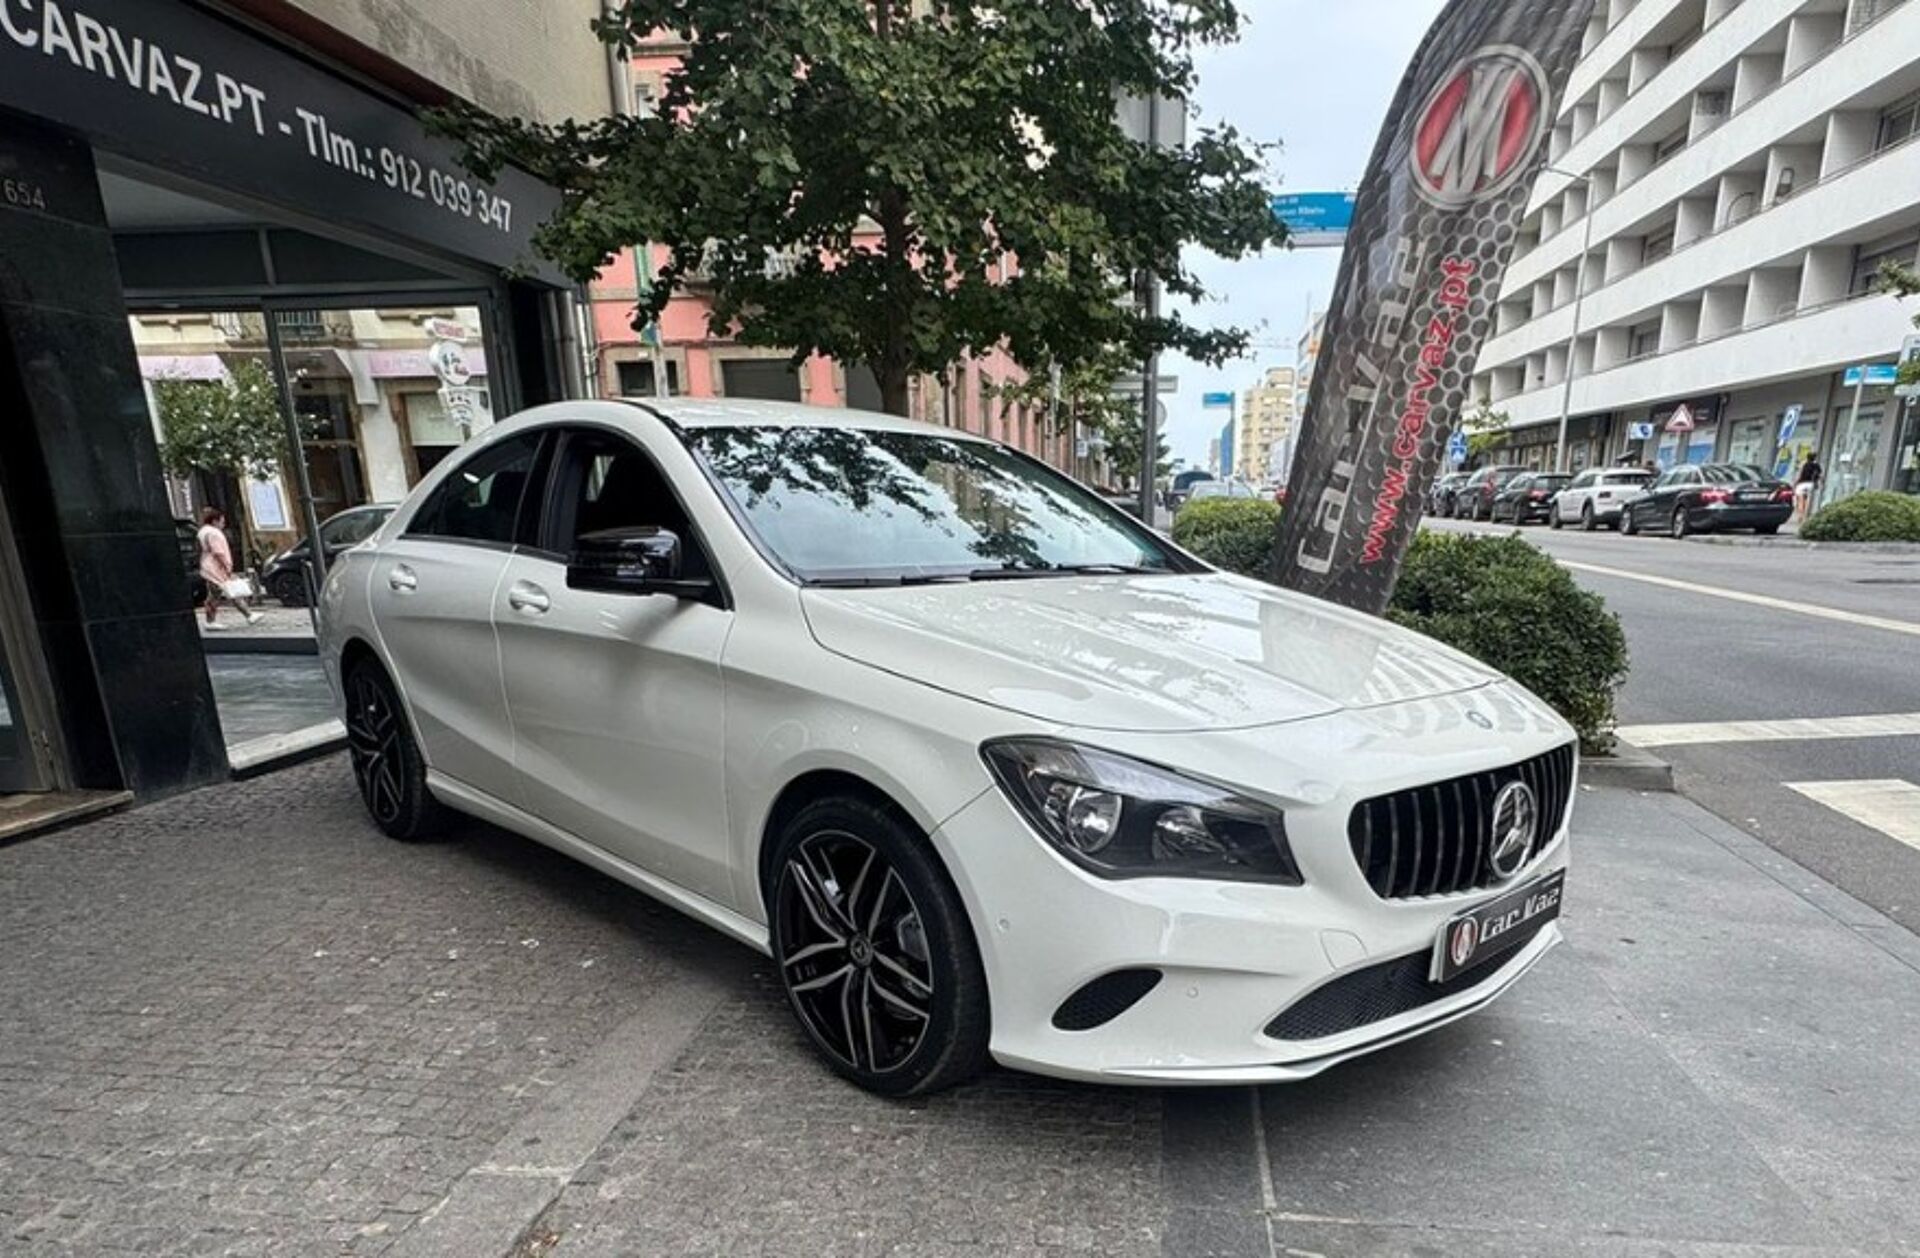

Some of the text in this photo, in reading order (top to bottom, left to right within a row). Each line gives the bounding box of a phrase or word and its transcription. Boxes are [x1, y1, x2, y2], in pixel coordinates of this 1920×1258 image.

[0, 0, 266, 136] CARVAZ.PT
[296, 106, 376, 180] Tlm.:
[380, 147, 426, 199] 912
[428, 168, 472, 217] 039
[476, 188, 512, 233] 347
[2, 178, 46, 210] 654
[1359, 255, 1477, 566] www.carvaz.pt
